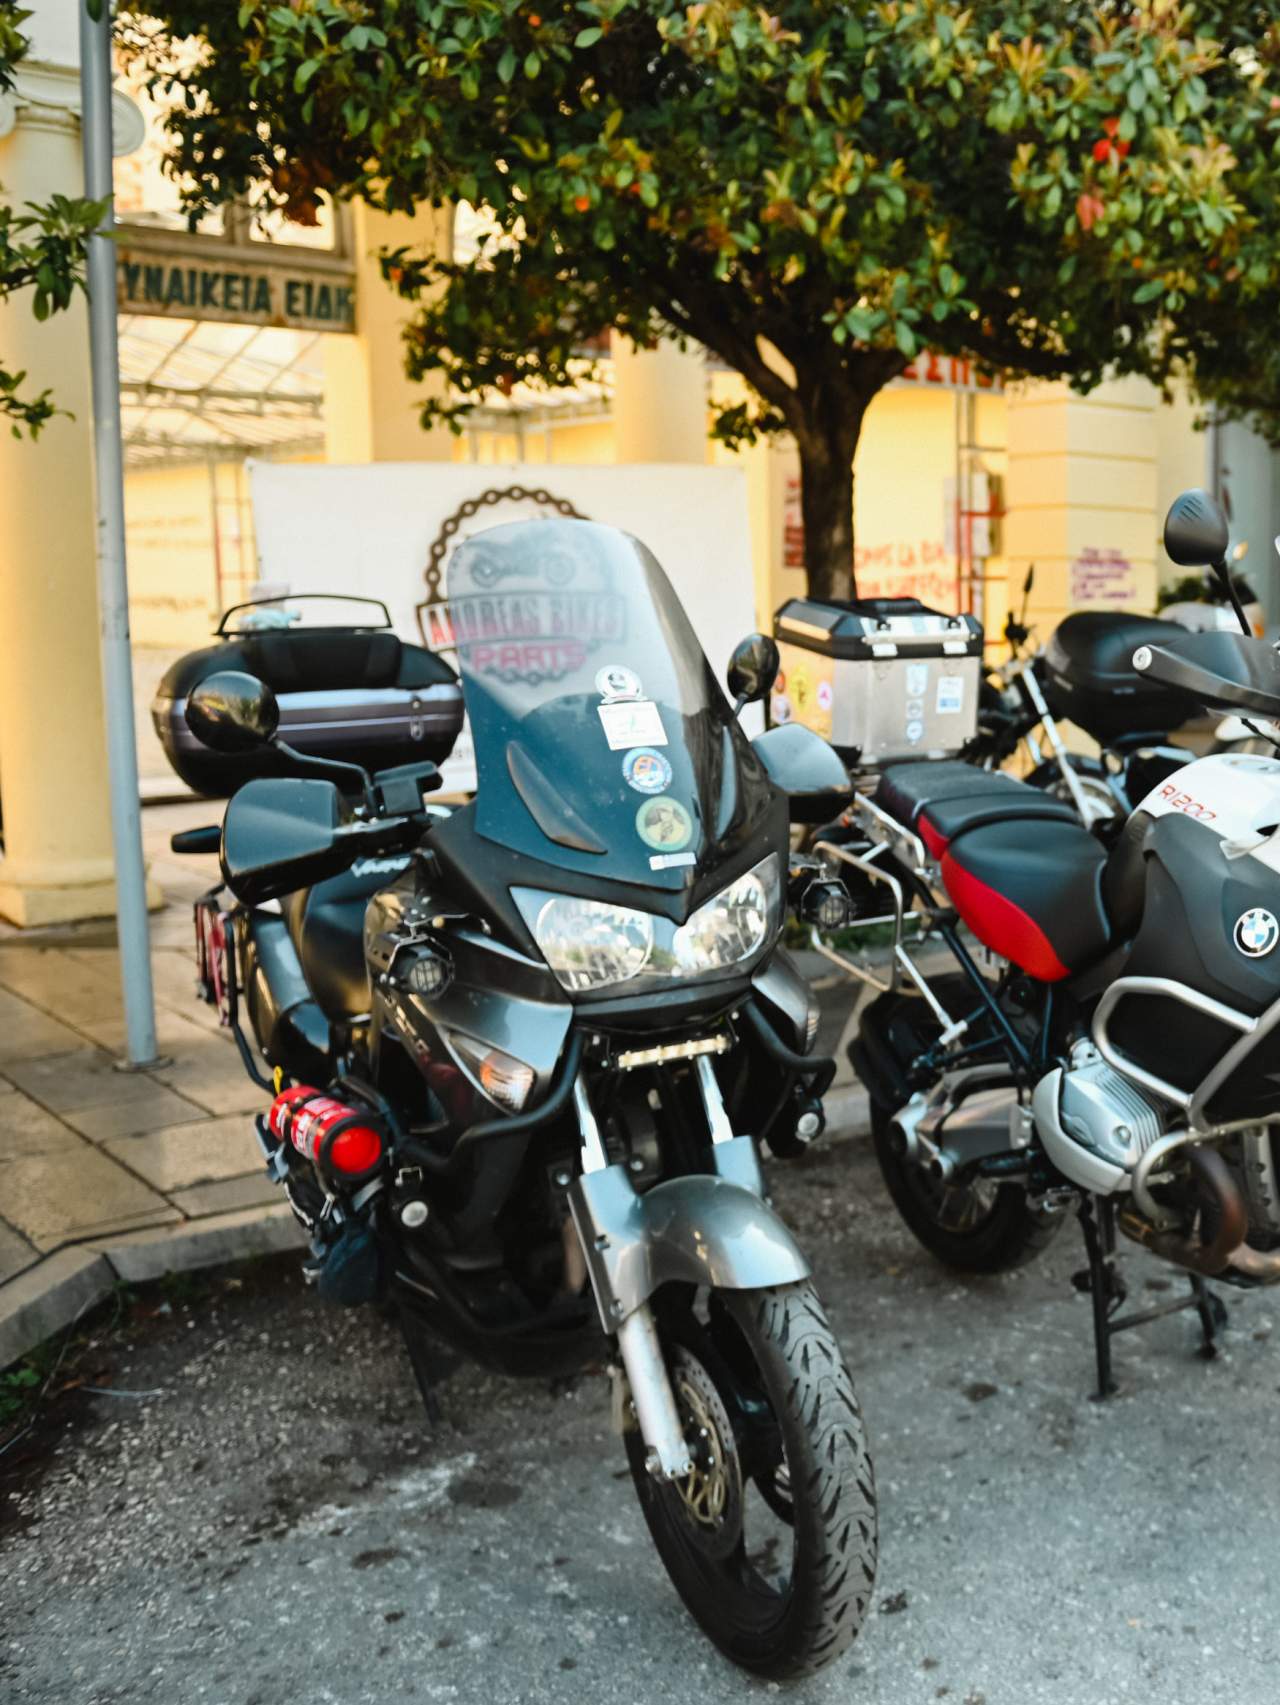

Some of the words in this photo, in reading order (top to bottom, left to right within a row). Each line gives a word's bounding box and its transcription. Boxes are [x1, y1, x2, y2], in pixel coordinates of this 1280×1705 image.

[117, 261, 272, 313] ΥΝΑΙΚΕΙΑ
[471, 641, 588, 674] PARTS
[1157, 784, 1217, 821] R1200
